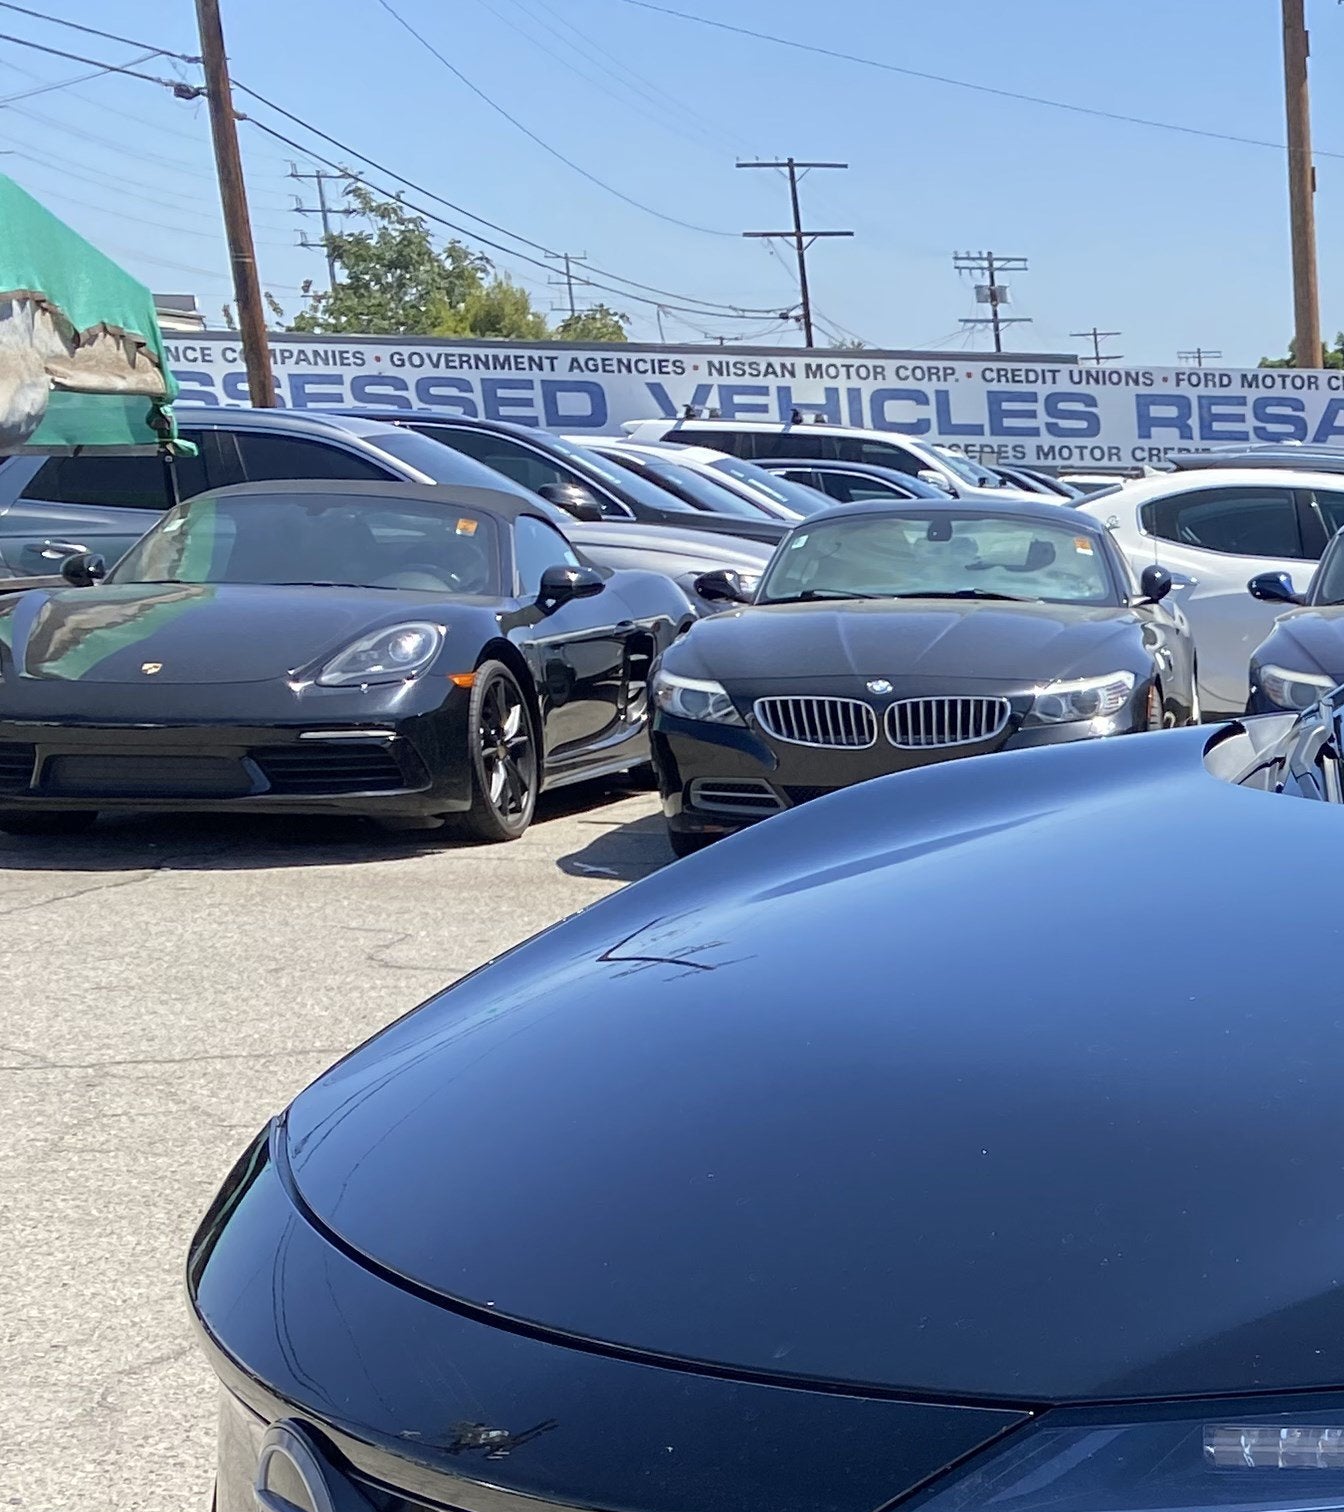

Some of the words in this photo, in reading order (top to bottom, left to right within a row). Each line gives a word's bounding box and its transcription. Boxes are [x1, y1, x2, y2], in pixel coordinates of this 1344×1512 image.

[221, 348, 366, 367] CPANIES
[389, 351, 559, 372] GOVERNMENT
[568, 356, 685, 376] AGENCIES
[707, 360, 796, 379] NISSAN
[804, 363, 887, 382] MOTOR
[895, 364, 959, 383] CORP.
[981, 367, 1061, 385] CREDIT
[1069, 369, 1154, 387] UNIONS
[1175, 372, 1232, 388] FORD
[1240, 373, 1320, 391] MOTOR
[645, 381, 1101, 438] VEHICLES
[931, 443, 1026, 460] EDES
[1036, 445, 1123, 462] MOTOR
[1131, 446, 1211, 462] CRE
